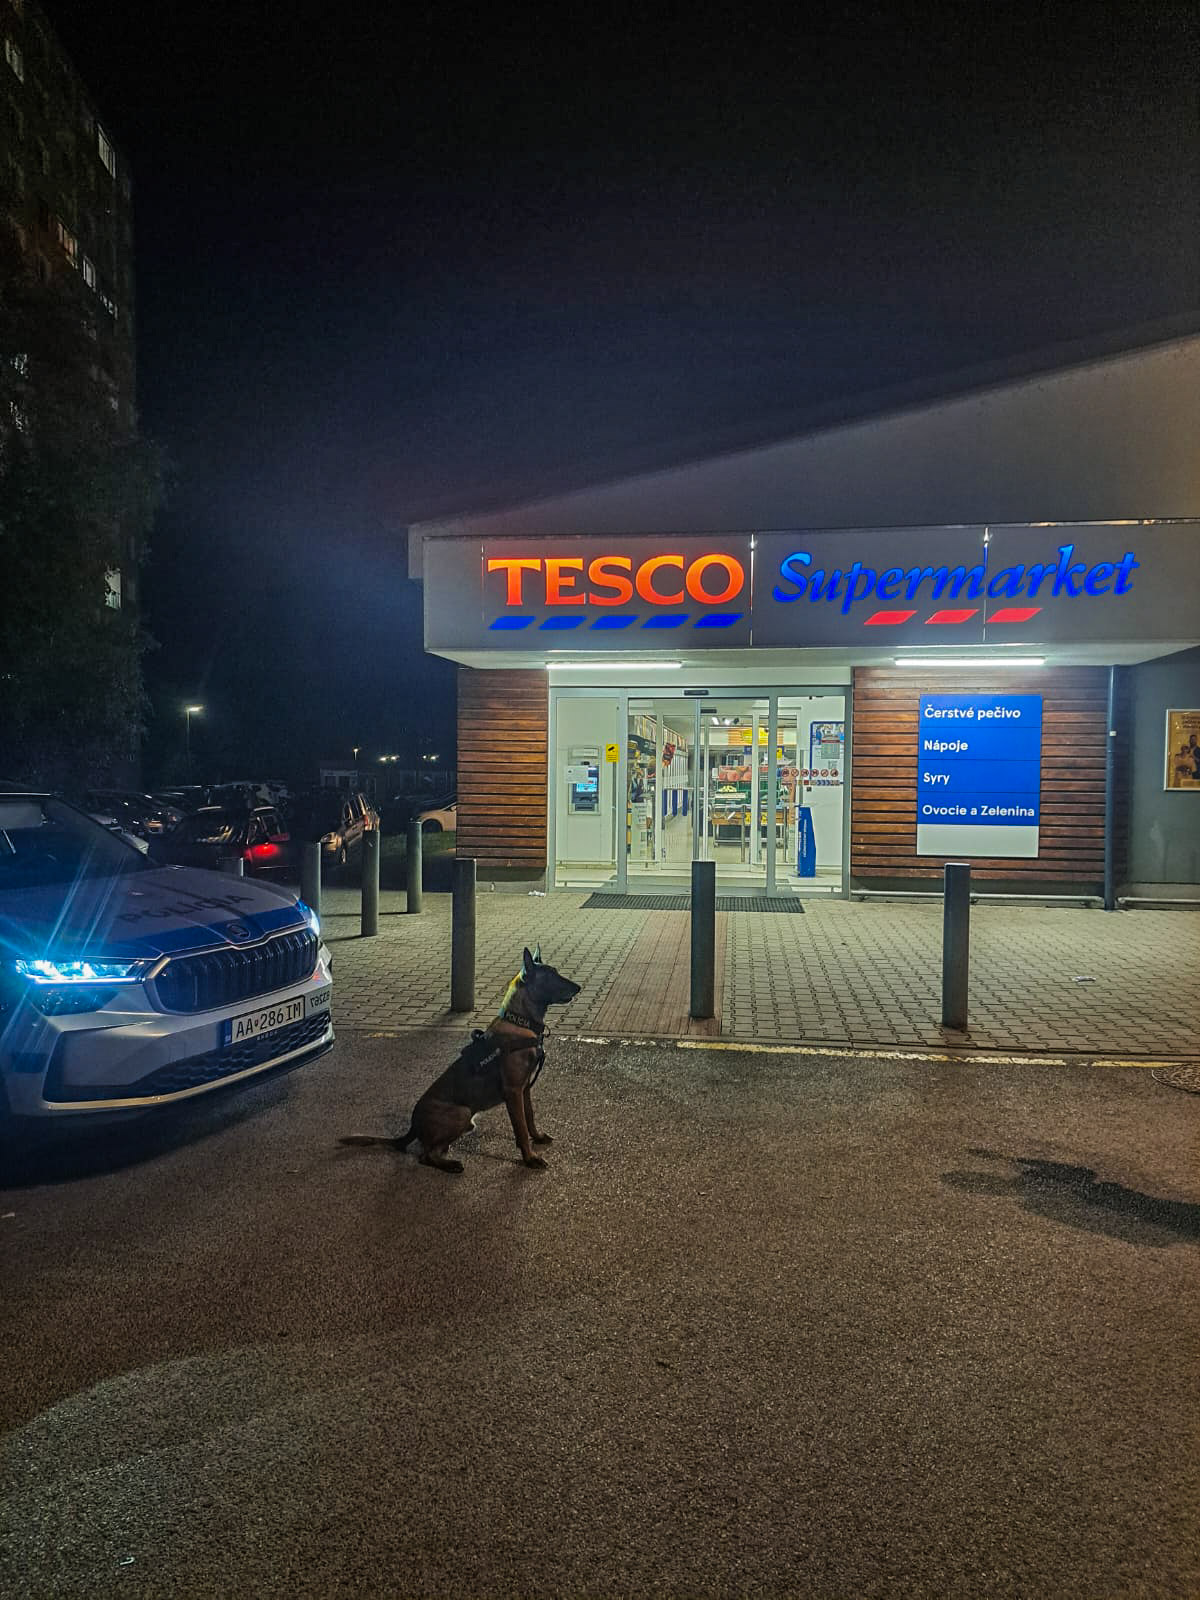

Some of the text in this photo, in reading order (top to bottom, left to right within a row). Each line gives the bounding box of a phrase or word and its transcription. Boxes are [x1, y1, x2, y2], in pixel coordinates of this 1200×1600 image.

[487, 553, 745, 607] TESCO
[772, 543, 1141, 616] Supermarket
[924, 703, 1021, 721] Čerstvé pečivo
[924, 739, 969, 753] Nápoje
[923, 772, 950, 786] Syry
[922, 804, 1035, 817] Ovocie a Zelenina
[235, 1018, 254, 1039] AA
